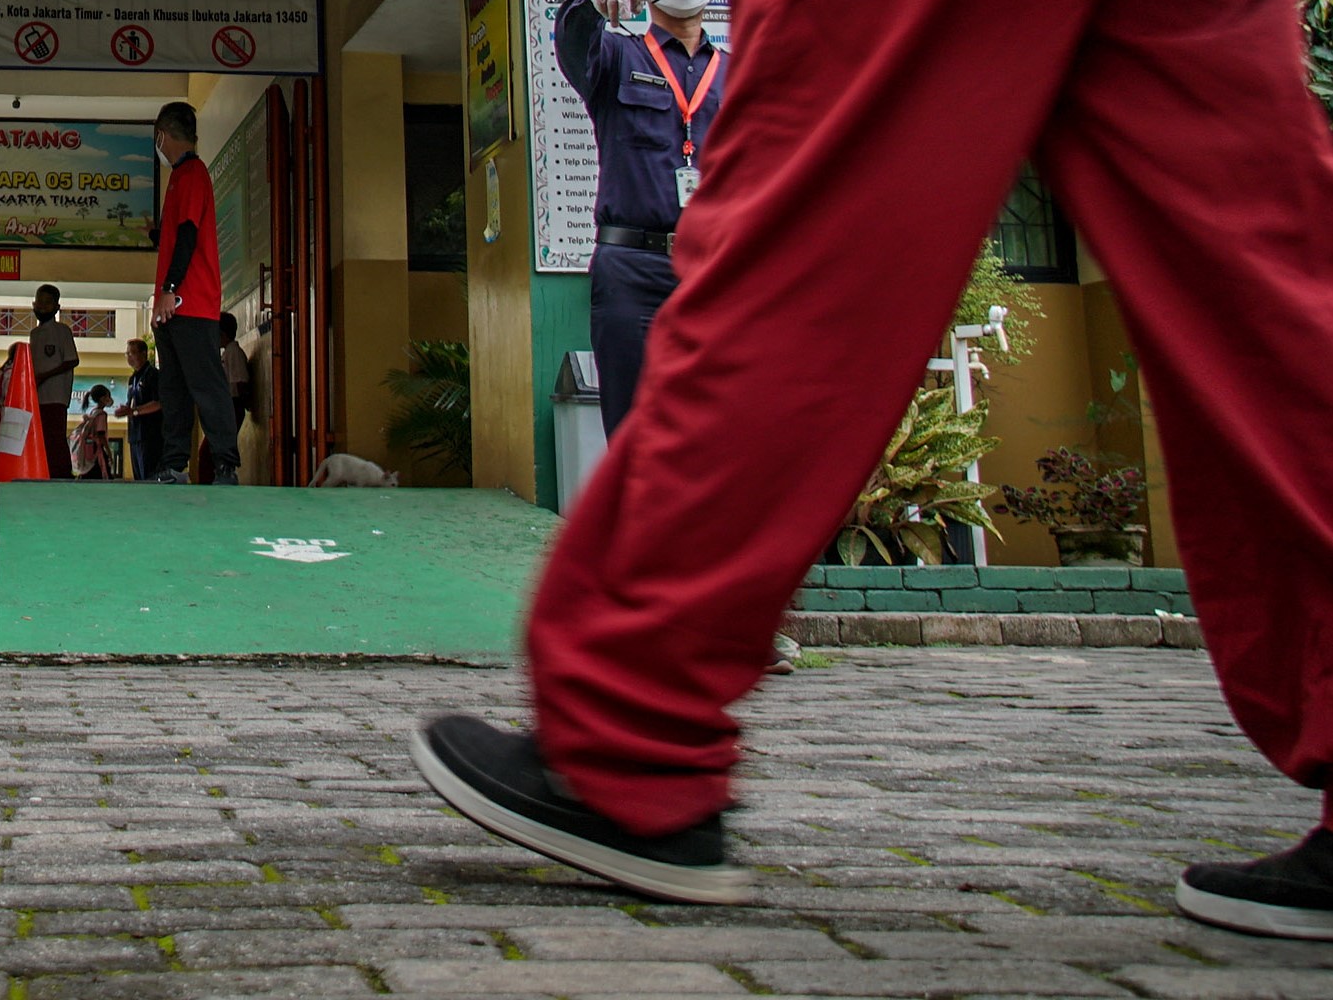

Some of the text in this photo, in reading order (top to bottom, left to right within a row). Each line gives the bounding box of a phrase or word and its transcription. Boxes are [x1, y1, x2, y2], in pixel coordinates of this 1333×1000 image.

[7, 5, 30, 18] Kota
[32, 7, 71, 20] Jakarta
[74, 7, 103, 20] Timur
[114, 9, 150, 21] Daerah
[153, 9, 188, 22] Khusus
[192, 10, 230, 23] Ibukota
[233, 10, 272, 24] Jakarta
[275, 11, 308, 24] 13450
[561, 96, 577, 105] Telp
[562, 111, 588, 120] Wilaya
[563, 127, 589, 135] Laman
[563, 142, 585, 150] Email
[564, 158, 580, 167] Telp
[45, 172, 73, 190] 05
[78, 172, 130, 192] PAGI
[566, 189, 587, 197] Email
[49, 195, 100, 207] TIMUR
[566, 205, 583, 214] Telp
[567, 221, 591, 229] Duren
[568, 237, 584, 245] Telp
